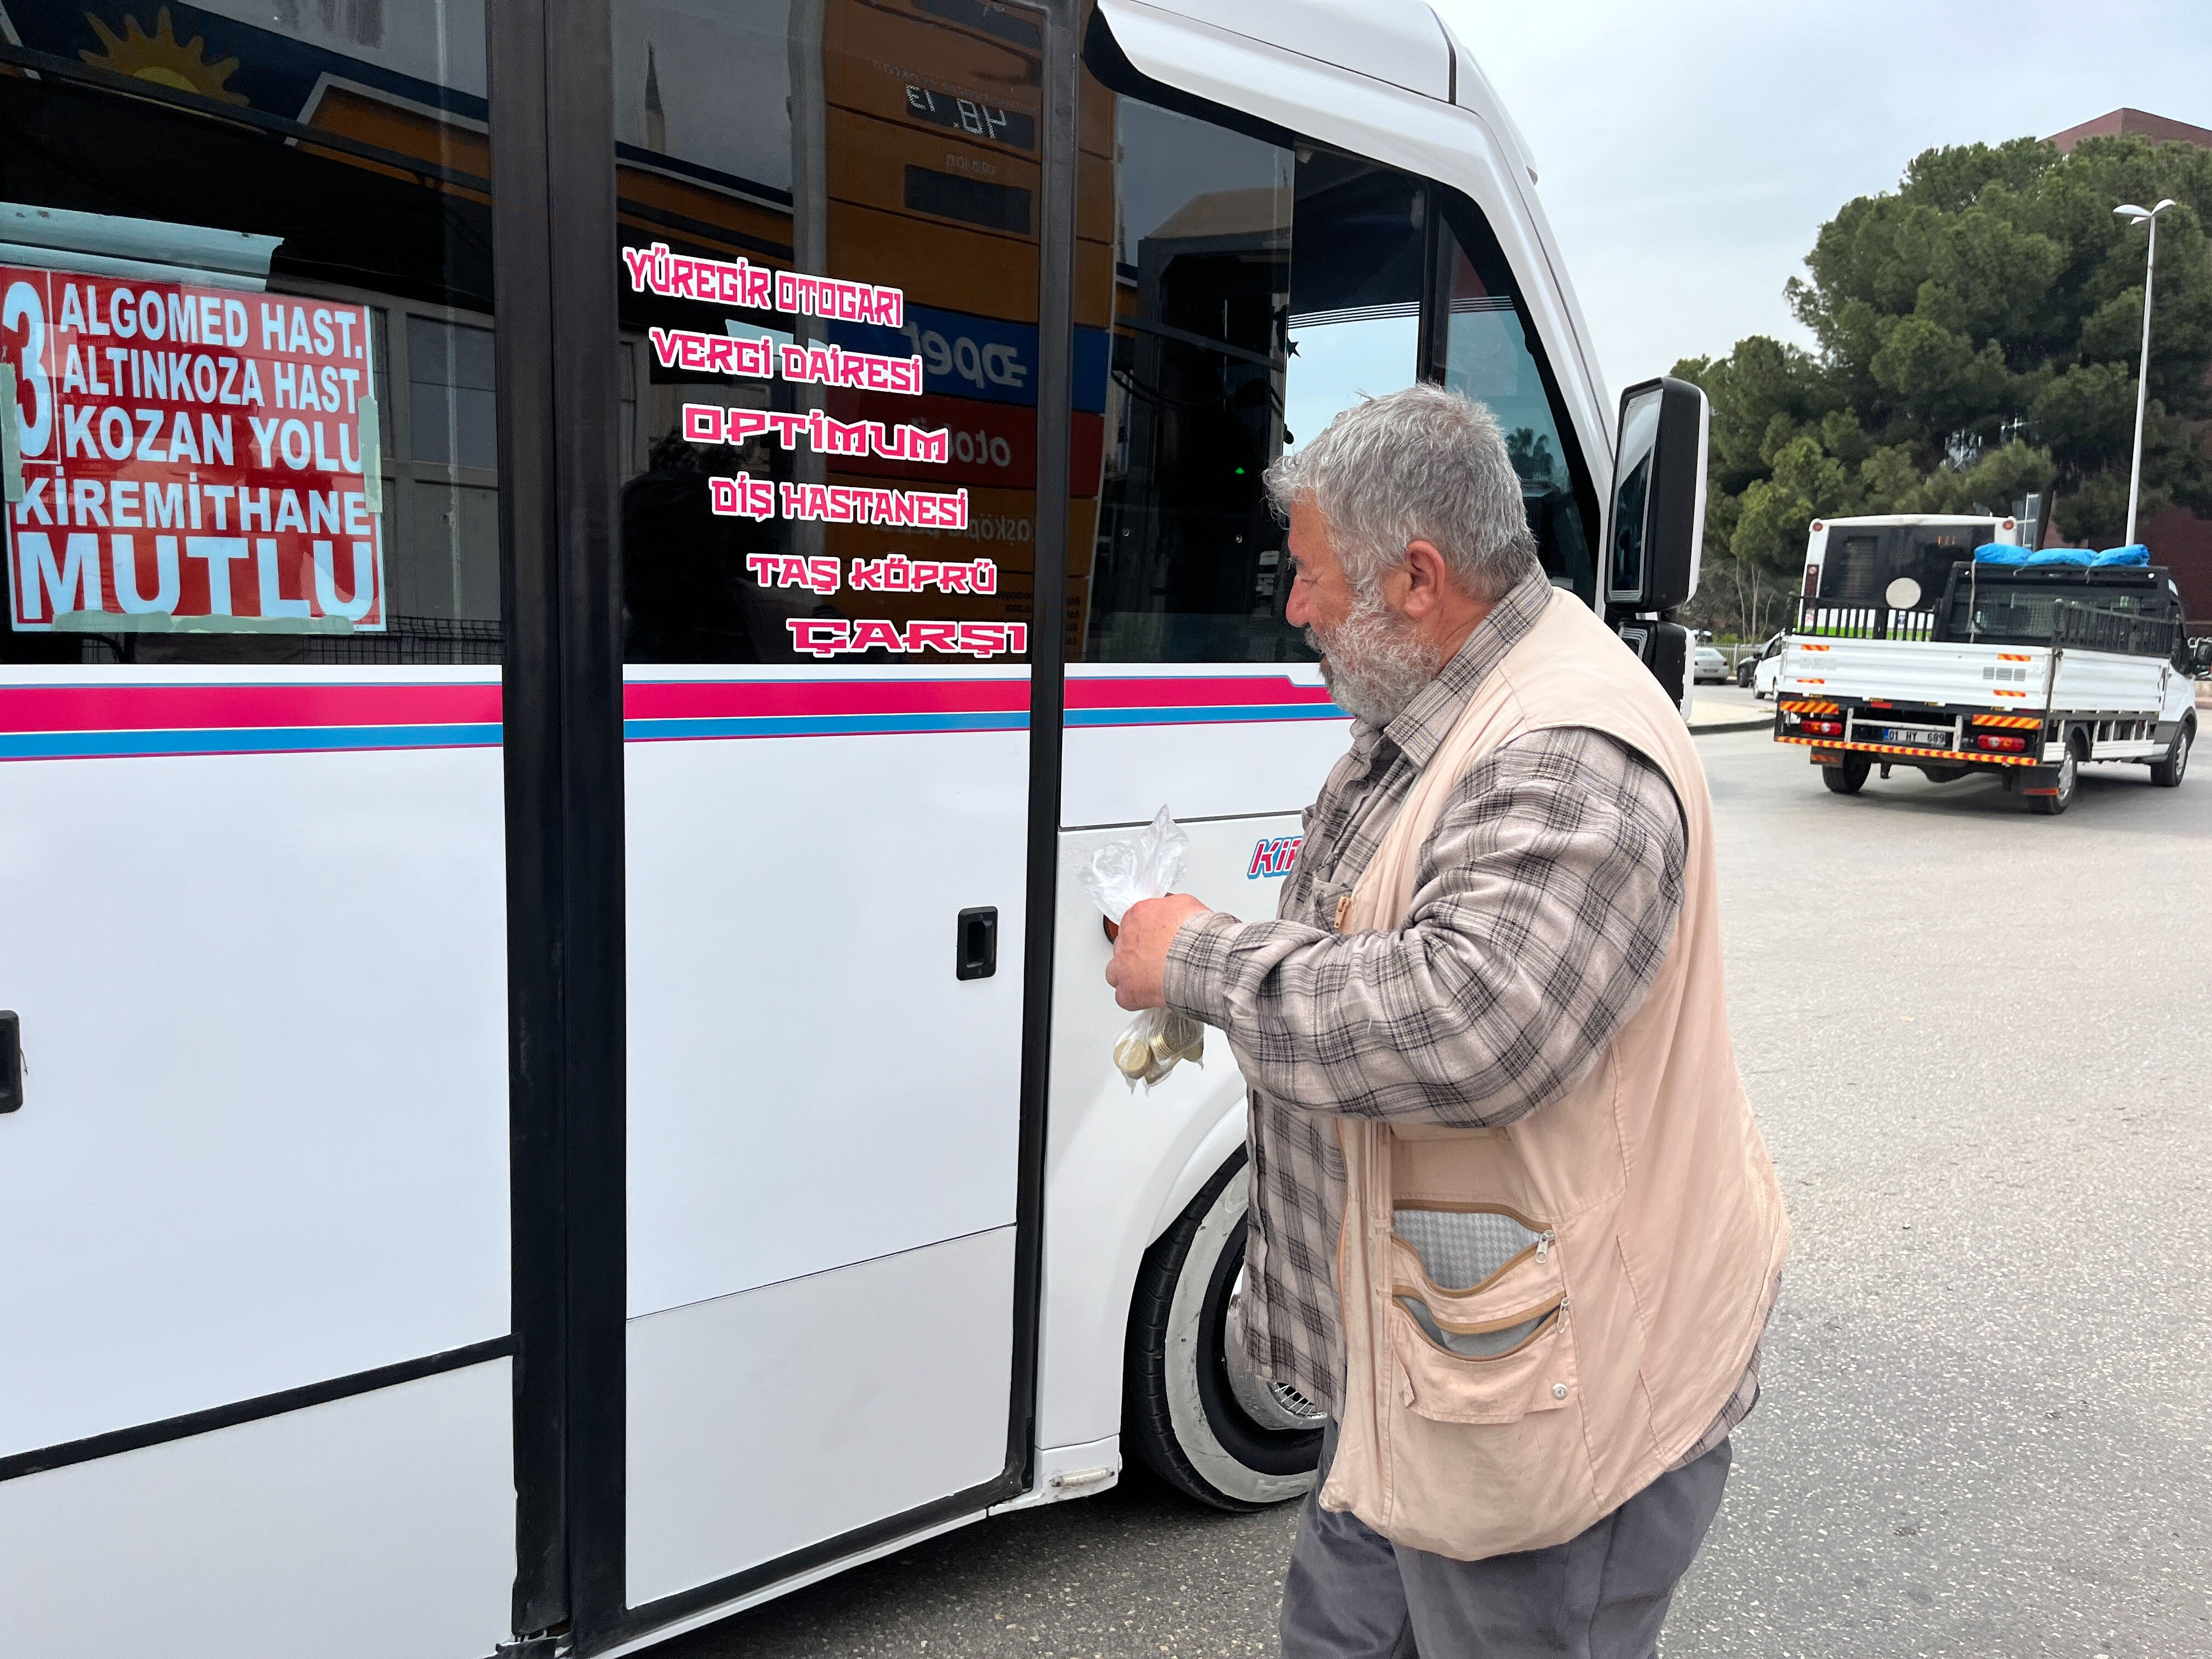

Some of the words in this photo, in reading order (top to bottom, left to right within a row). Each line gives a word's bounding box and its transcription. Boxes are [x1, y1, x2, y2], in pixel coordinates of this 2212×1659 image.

[60, 283, 249, 348] ALGOMED
[260, 302, 363, 360] HAST.
[778, 274, 901, 327] OTOGARI
[3, 281, 52, 458] 3
[63, 345, 265, 407] ALTINKOZA
[274, 360, 360, 414] HAST
[651, 329, 772, 377] VERGİ
[781, 346, 921, 393] DAİRESİ
[64, 404, 234, 466] KOZAN
[249, 417, 363, 473] YOLU
[684, 405, 947, 462] OPTİMUM
[15, 466, 371, 535] KİREMİTHANE
[710, 473, 773, 521] DİŞ
[781, 484, 967, 528] HASTANESİ
[18, 532, 373, 622] MUTLU
[749, 555, 839, 593] TAŞ
[850, 556, 995, 592] KÖPRÜ
[788, 620, 1025, 656] ÇARŞI
[1889, 730, 1898, 741] 01
